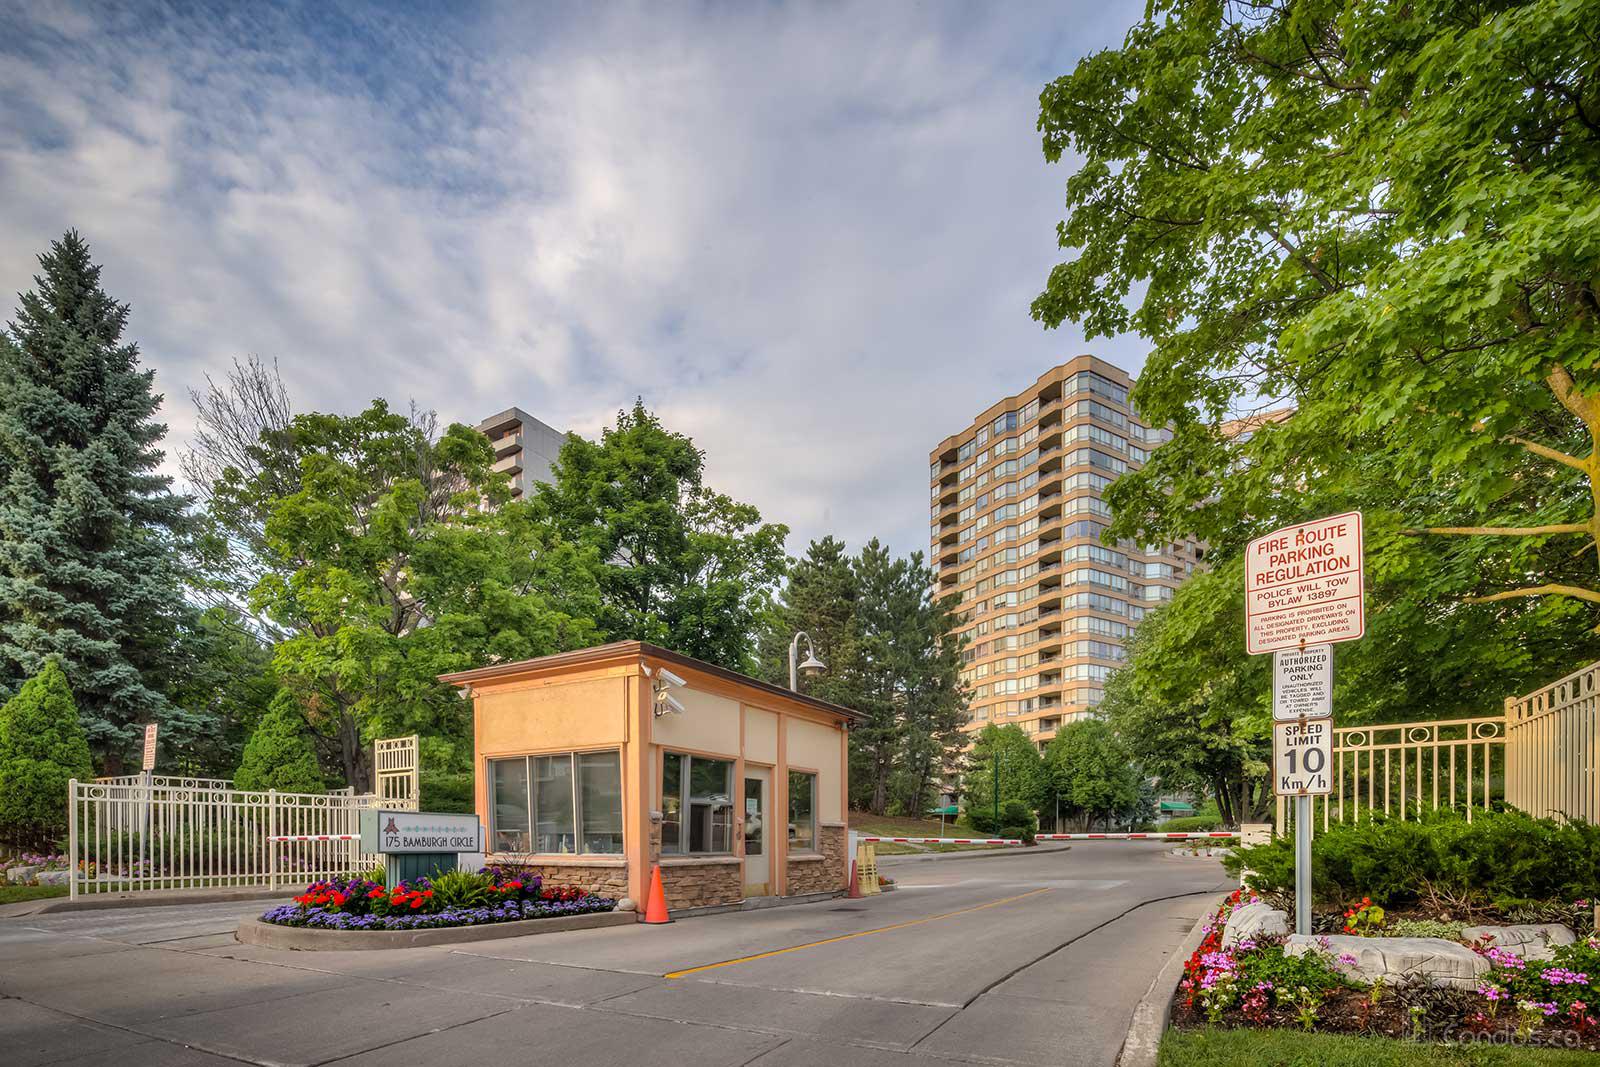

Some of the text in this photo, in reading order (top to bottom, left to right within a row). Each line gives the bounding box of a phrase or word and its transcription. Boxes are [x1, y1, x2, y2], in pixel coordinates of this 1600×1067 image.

[1258, 524, 1347, 555] FIRE ROUTE
[1270, 543, 1334, 567] PARKING
[1256, 555, 1350, 585] REGULATION
[1257, 577, 1349, 600] POLICE WILL TOW
[1268, 589, 1337, 608] BYLAW 13897
[1260, 614, 1287, 623] PARKING
[1297, 606, 1335, 616] PROHIBITED
[1266, 618, 1304, 629] DESIGNATED
[1306, 611, 1343, 622] DRIVEWAYS
[1312, 618, 1349, 629] EXCLUDING
[1258, 625, 1350, 645] DESIGNATED PARKING AREAS
[1280, 655, 1327, 666] AUTHORIZED
[1284, 664, 1323, 674] PARKING
[1290, 673, 1314, 681] ONLY
[1285, 724, 1322, 736] SPEED
[1286, 735, 1321, 746] LIMIT
[1284, 748, 1325, 773] 10
[1282, 774, 1326, 789] Km/h
[386, 836, 474, 847] 175 BAMBURGH CIRCLE
